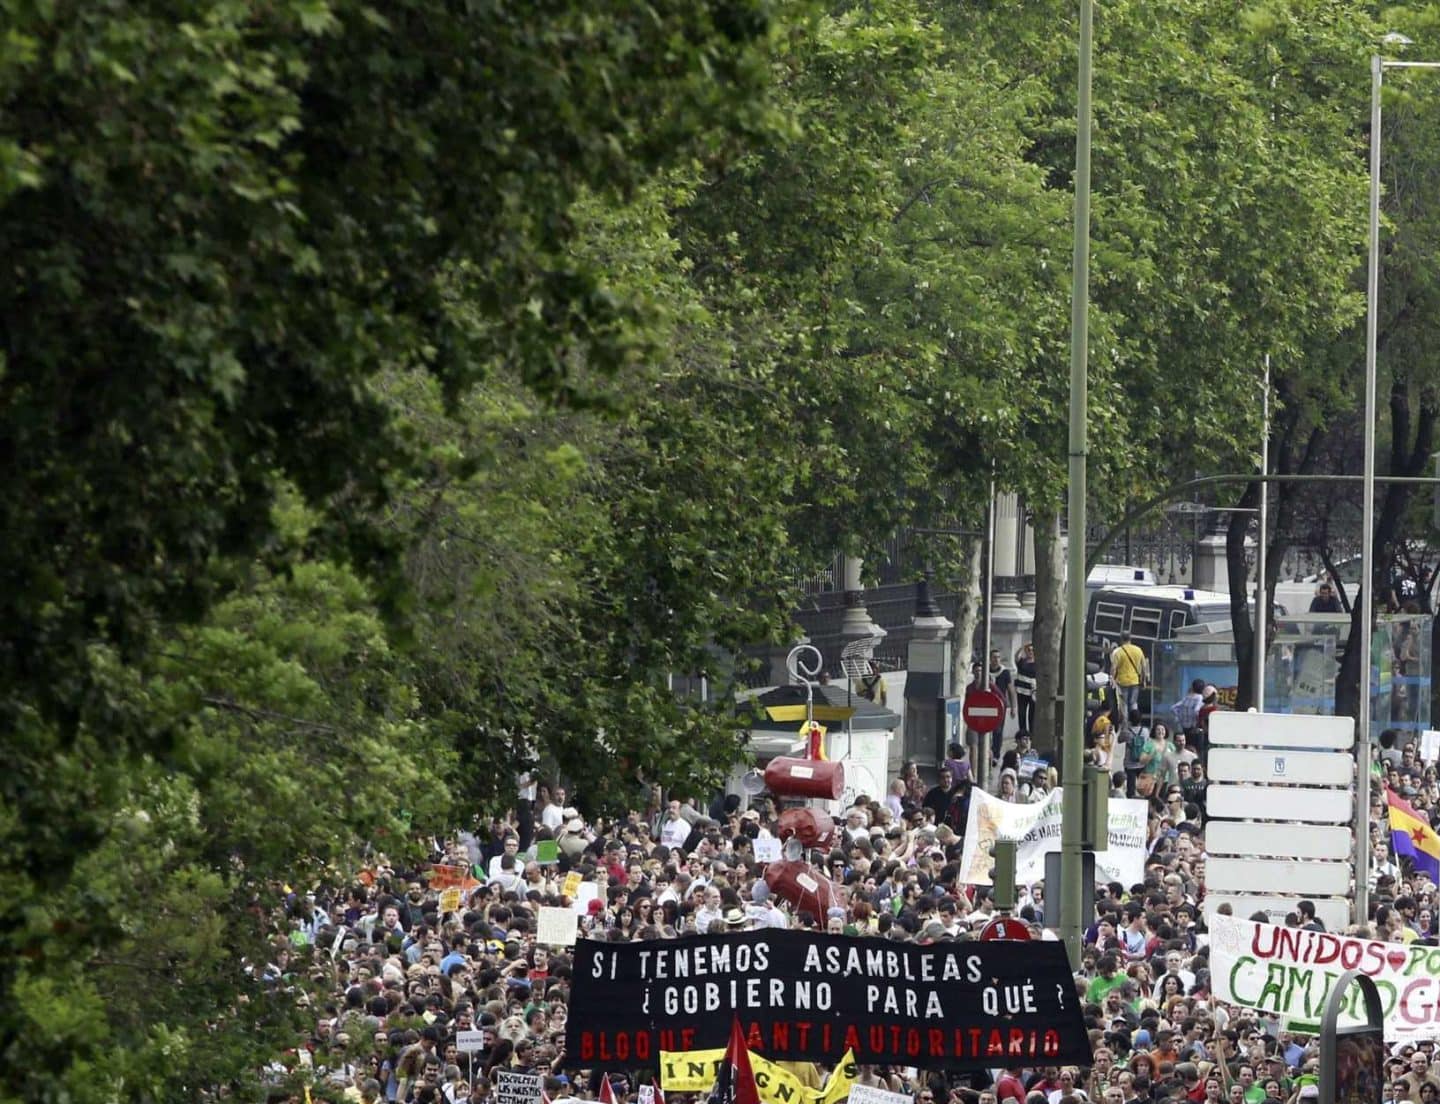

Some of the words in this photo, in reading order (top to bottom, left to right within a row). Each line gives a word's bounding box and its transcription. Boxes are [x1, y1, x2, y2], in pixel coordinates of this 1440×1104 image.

[591, 951, 618, 980] SI
[638, 941, 771, 980] TENEMOS
[803, 943, 983, 984] ASAMBLEAS
[867, 984, 945, 1019] PARA
[747, 1021, 1061, 1058] ANTIAUTORITARIO
